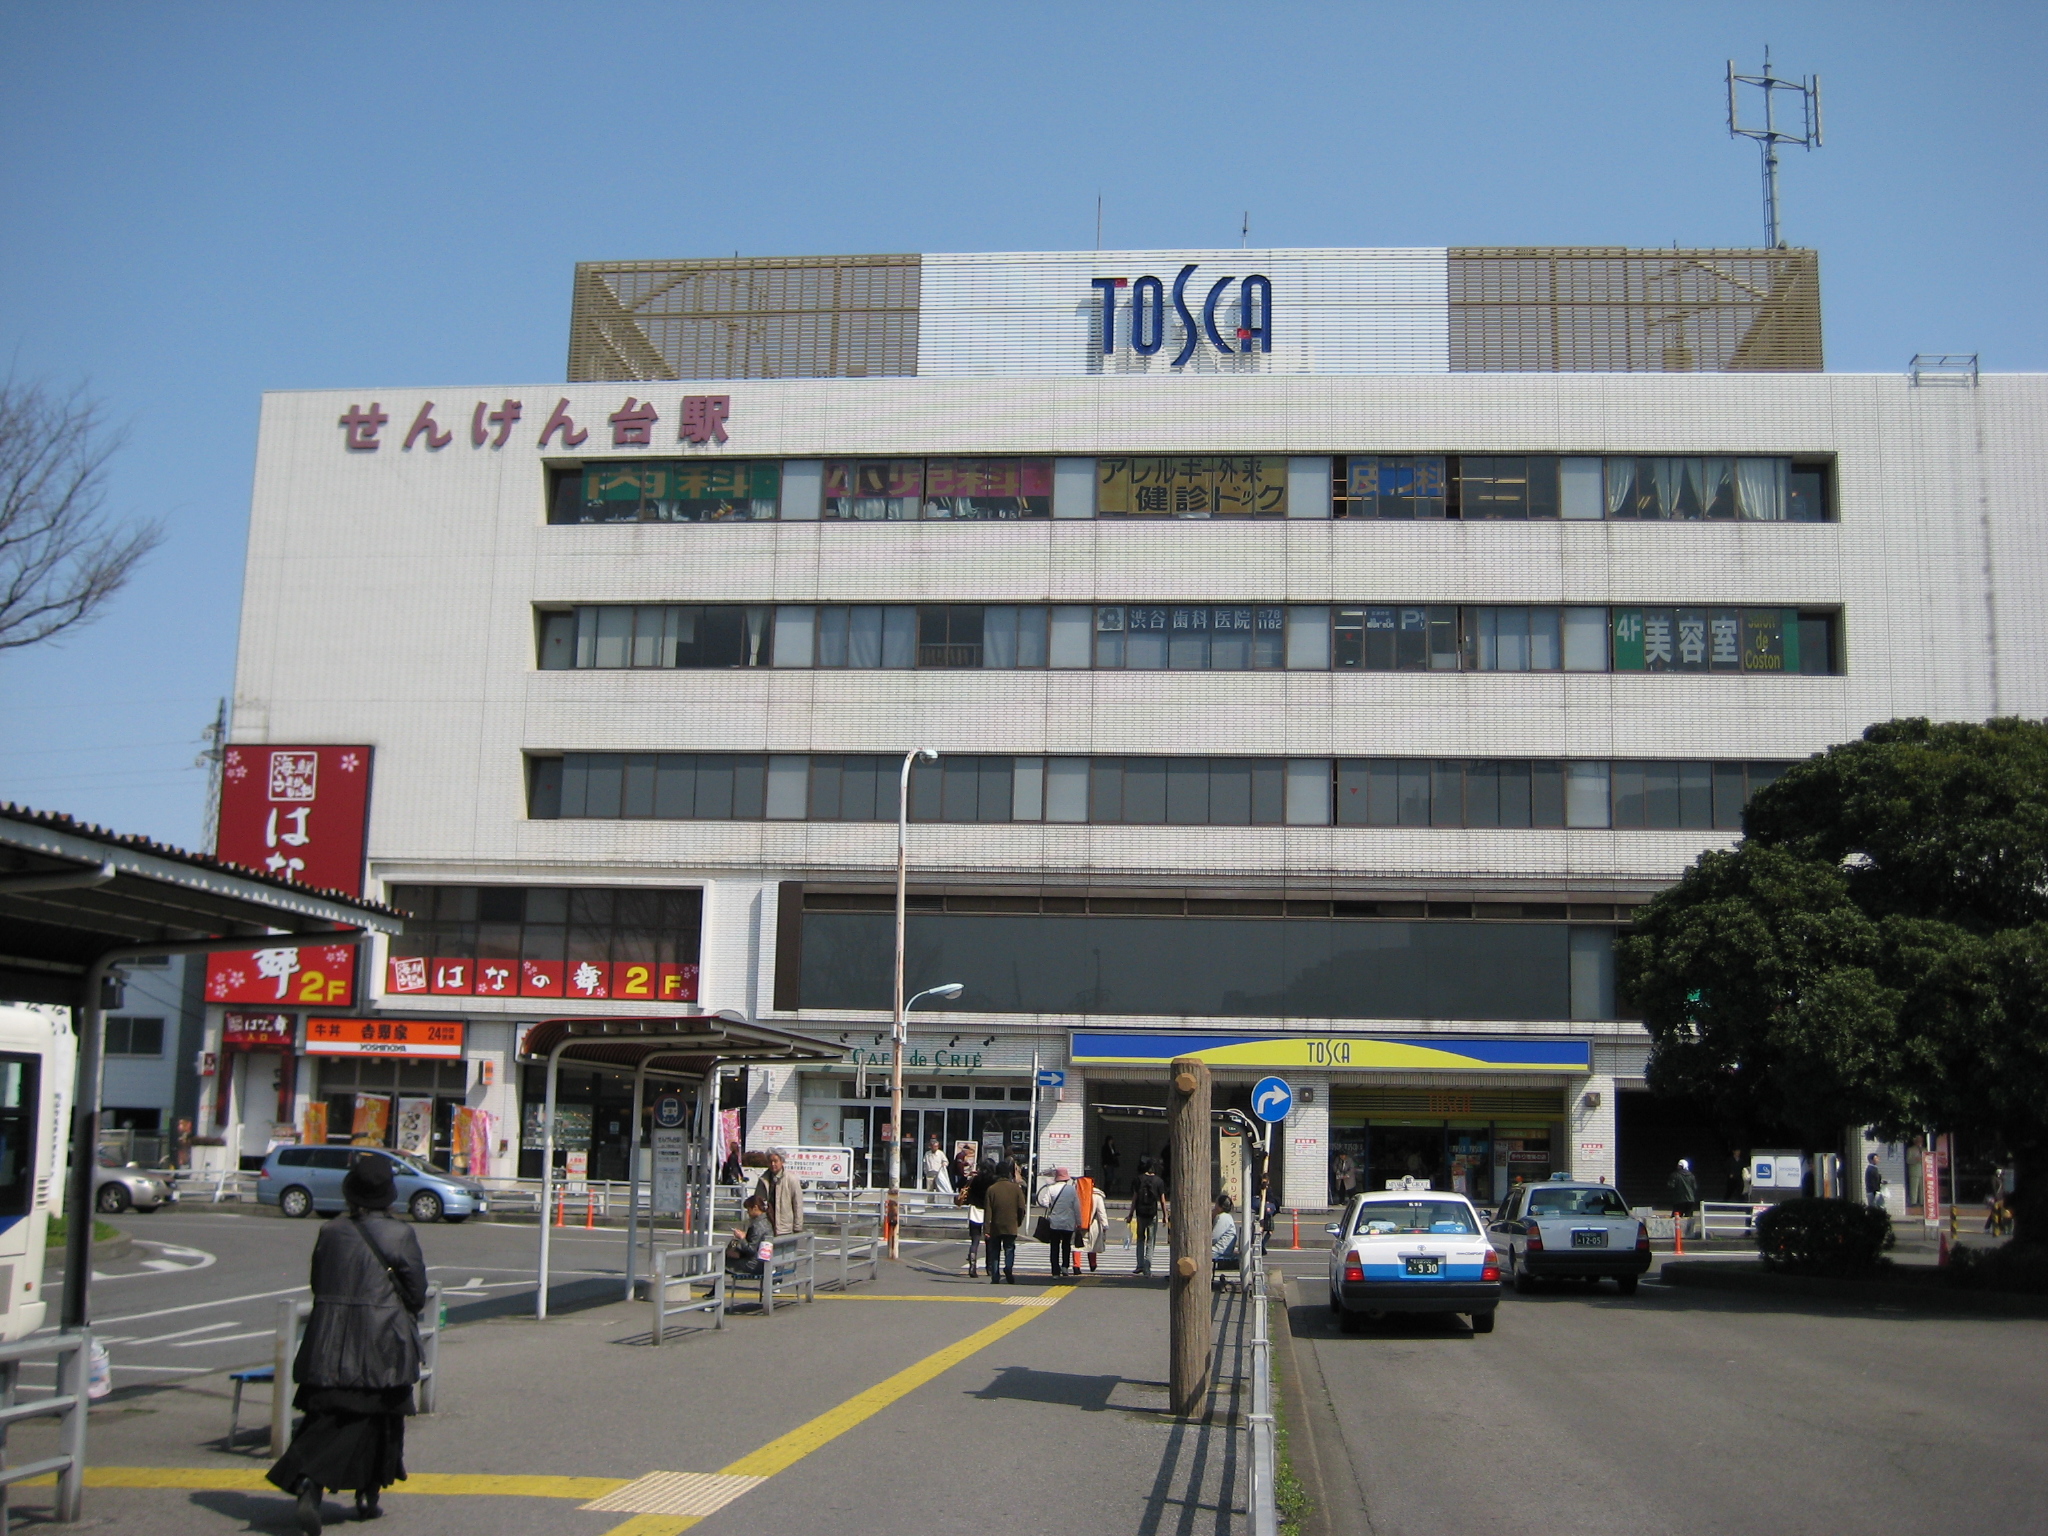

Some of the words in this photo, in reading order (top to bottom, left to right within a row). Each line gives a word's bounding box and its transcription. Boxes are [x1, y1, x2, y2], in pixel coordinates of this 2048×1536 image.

[1091, 264, 1272, 366] TOSCA
[340, 394, 730, 450] せんげん台駅
[587, 463, 750, 500] 内科
[828, 462, 1020, 496] 小児科
[1101, 458, 1263, 485] アレルギー外来
[1135, 484, 1285, 512] 健診ドック
[1130, 609, 1251, 630] 渋谷歯科医院
[1258, 619, 1282, 630] 1182
[1616, 614, 1641, 642] 4F
[1645, 615, 1739, 664] 美容室
[1755, 630, 1769, 650] de
[1745, 651, 1781, 670] Coston
[299, 970, 346, 1002] 2F
[437, 962, 602, 996] はなの舞
[626, 966, 682, 995] 2F
[315, 1023, 341, 1037] 牛丼
[427, 1026, 442, 1041] 24
[852, 1048, 890, 1065] CAF
[909, 1049, 928, 1066] de
[1306, 1038, 1350, 1067] TOSCA
[1230, 1142, 1238, 1203] タクシーのりば
